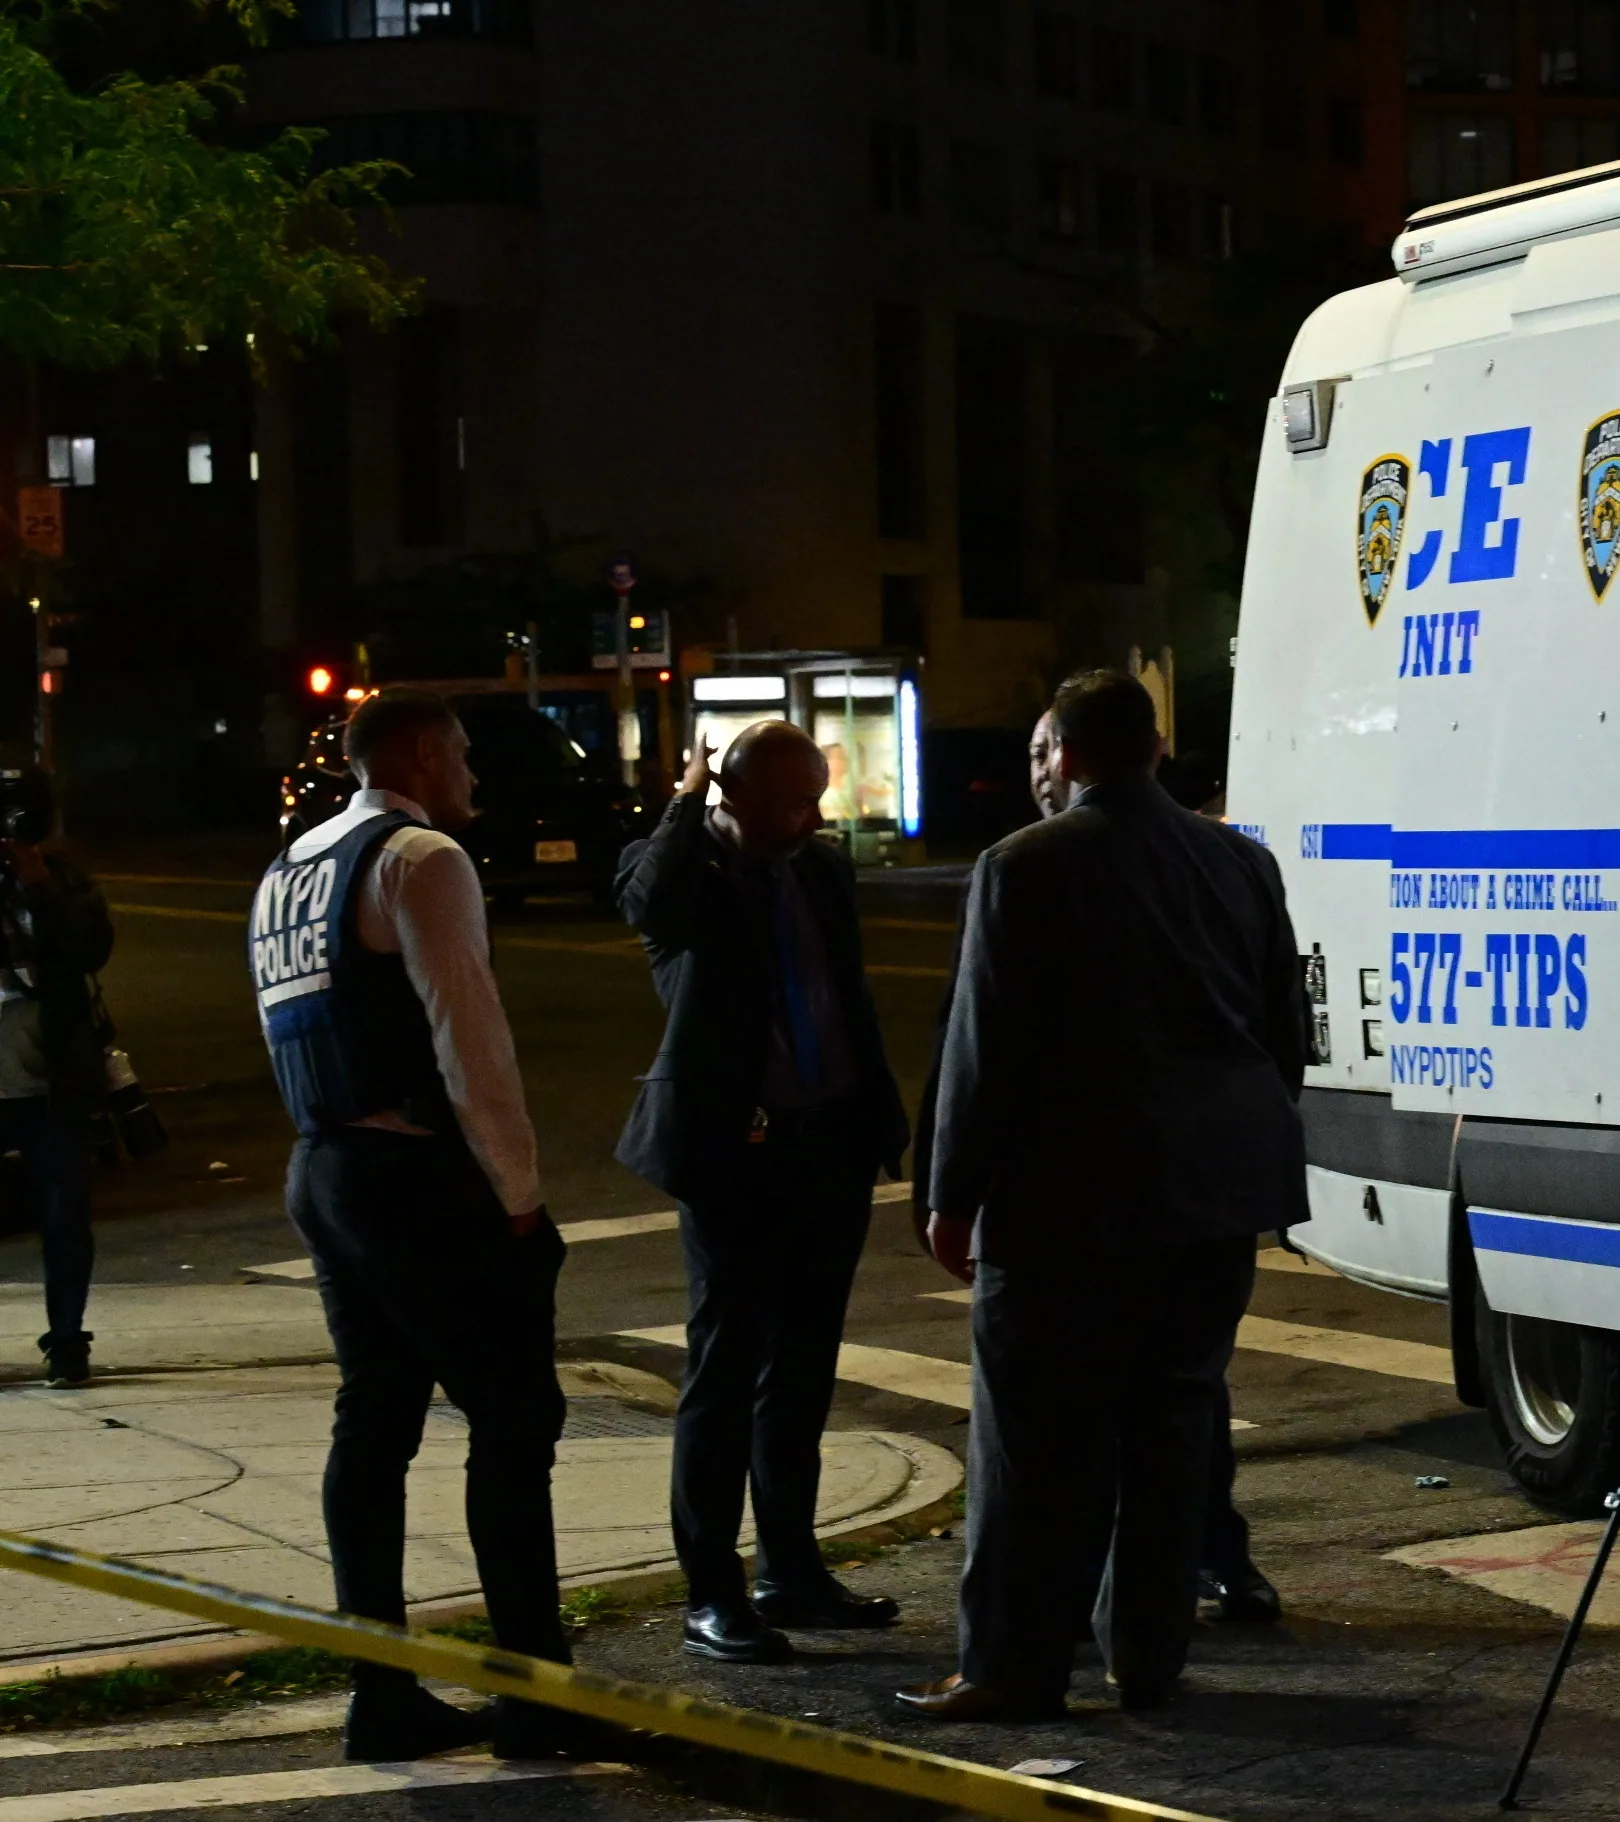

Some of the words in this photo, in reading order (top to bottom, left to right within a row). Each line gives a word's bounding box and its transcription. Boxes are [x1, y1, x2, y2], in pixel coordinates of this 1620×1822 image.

[26, 515, 60, 536] 25
[253, 859, 337, 938] NYPD
[1428, 873, 1479, 909] ABOUT
[1486, 874, 1497, 910] A
[1504, 874, 1555, 911] CRIME
[253, 920, 330, 988] POLICE
[1390, 933, 1588, 1030] 577-TIPS
[1391, 1045, 1494, 1089] NYPDTIPS
